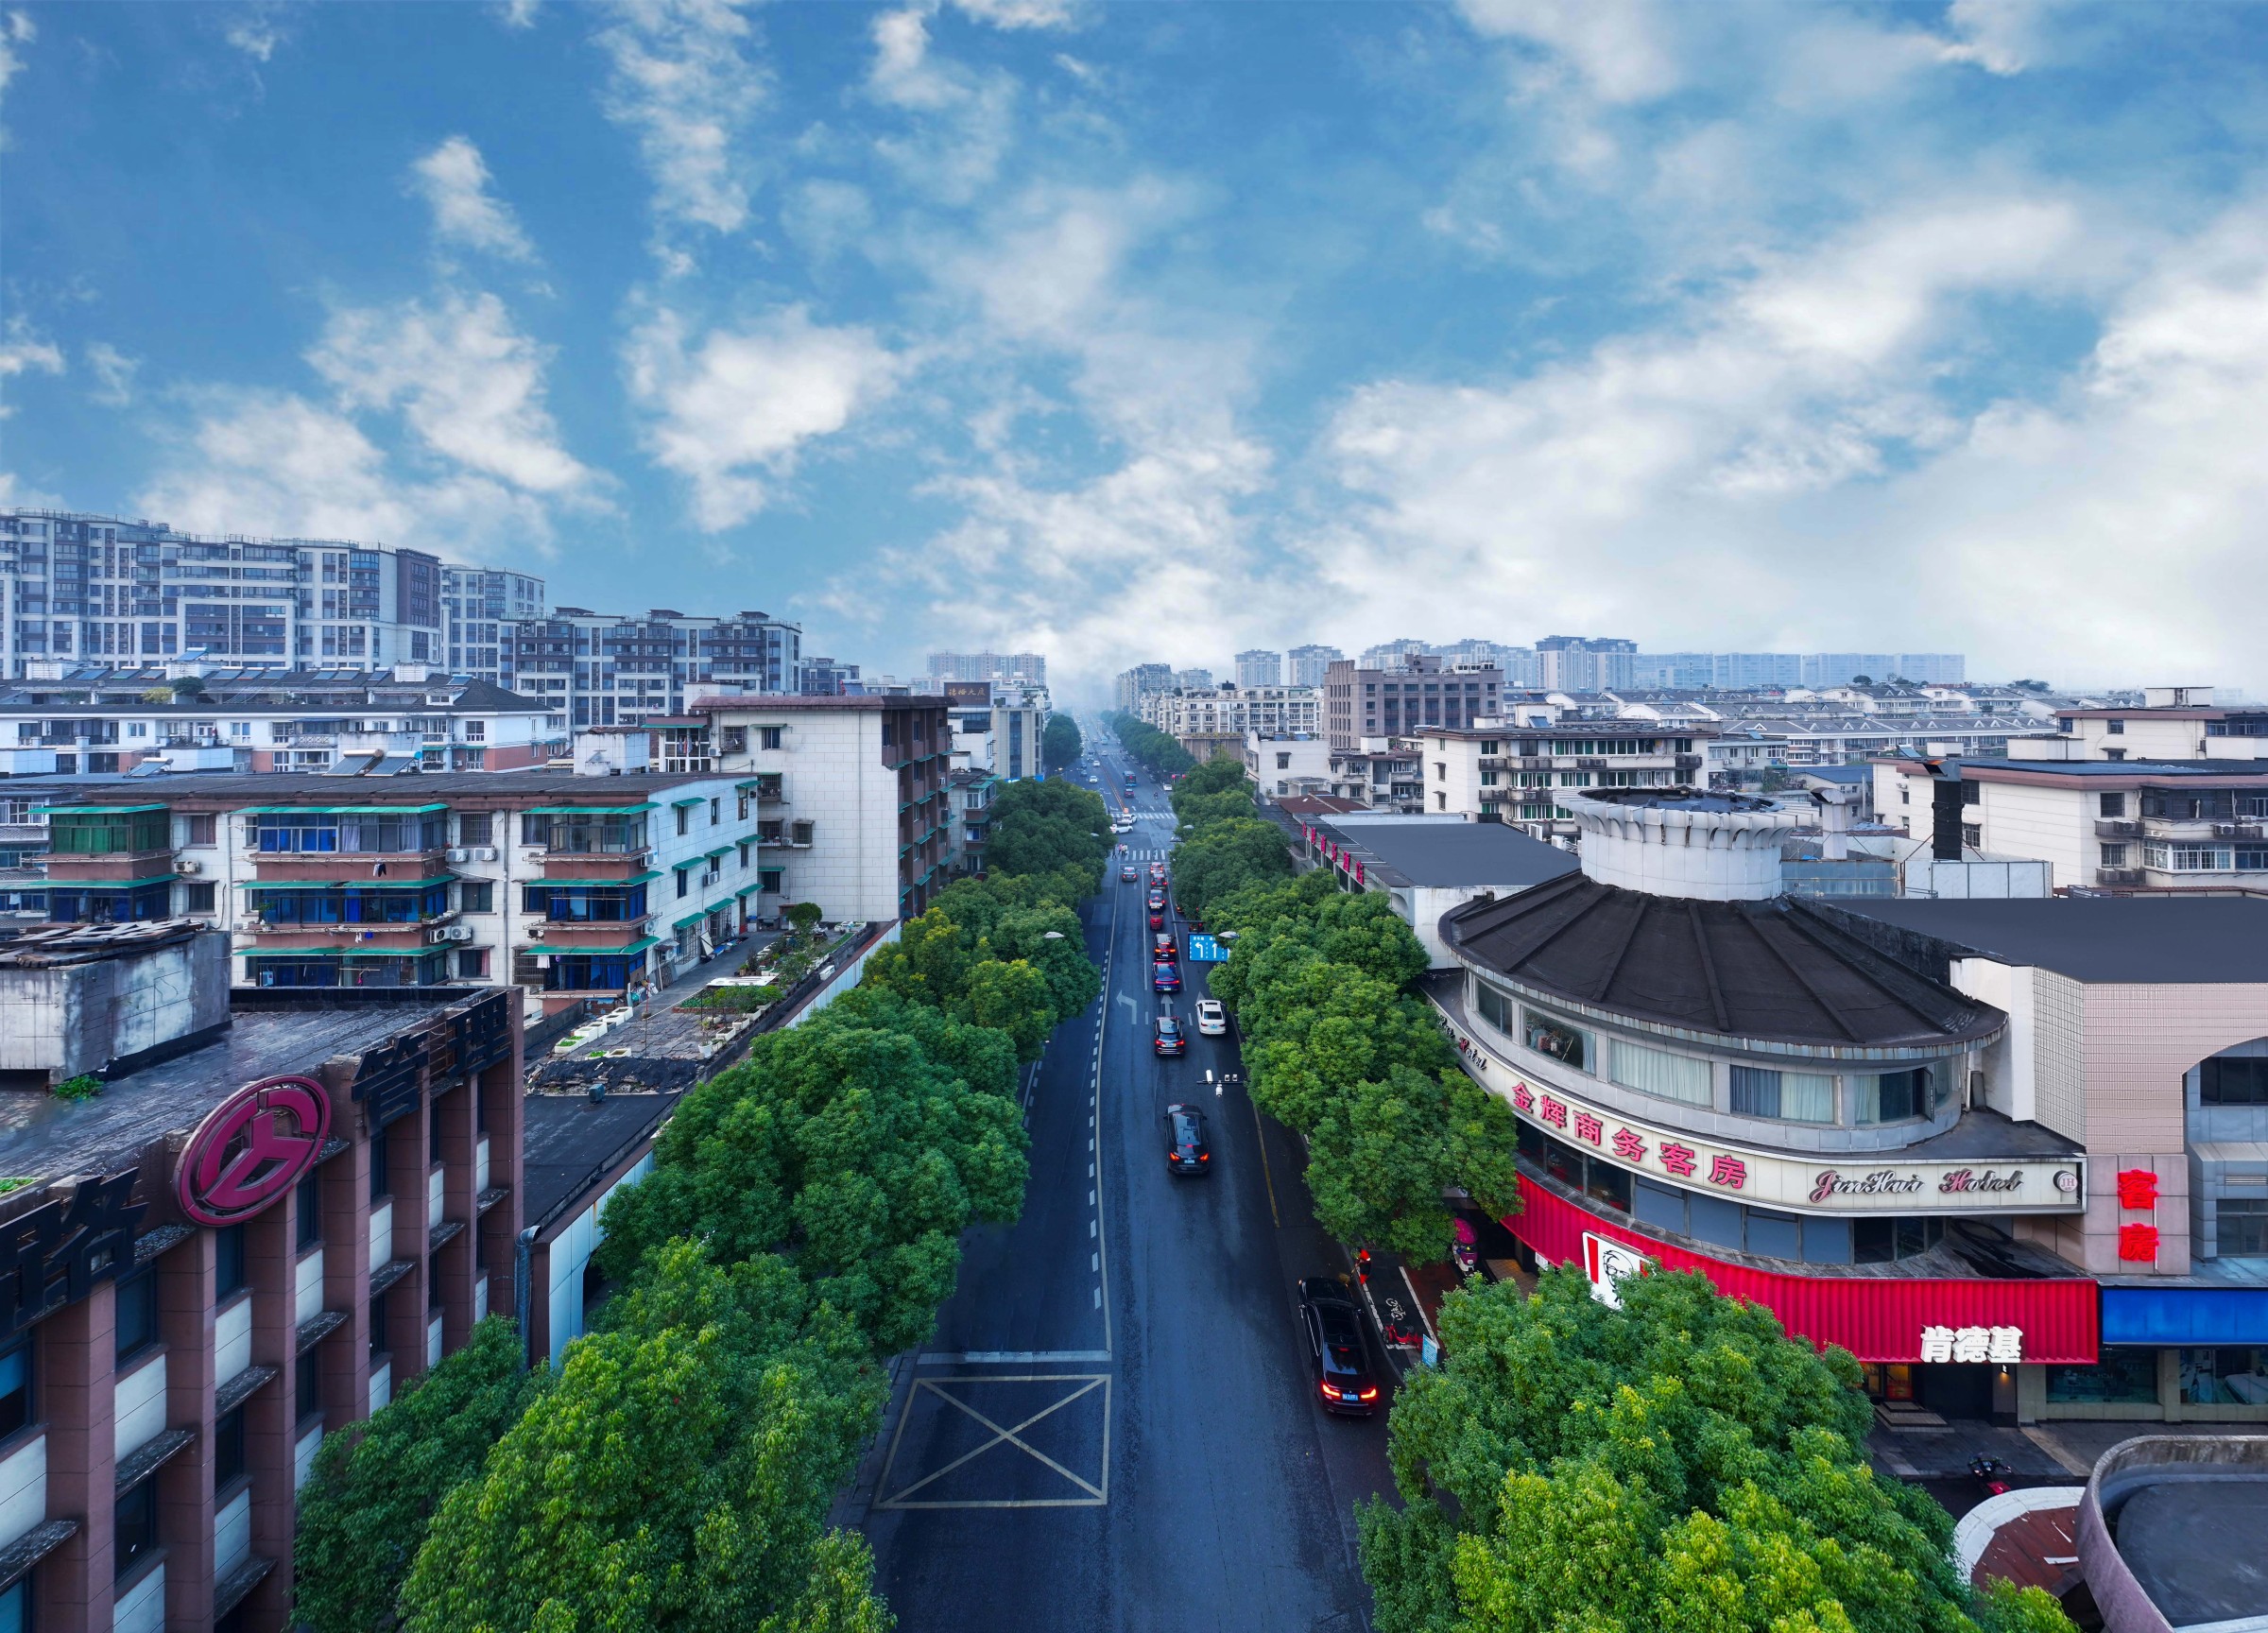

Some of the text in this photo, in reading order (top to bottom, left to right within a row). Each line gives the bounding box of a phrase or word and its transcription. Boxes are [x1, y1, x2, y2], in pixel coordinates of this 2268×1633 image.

[352, 990, 510, 1131] 管理
[1458, 1037, 1486, 1070] Hotel
[1512, 1082, 1747, 1190] 金辉商务客房
[1809, 1168, 2023, 1203] JinHui Hotel
[2061, 1177, 2075, 1187] JH
[2118, 1169, 2159, 1262] 客房
[1920, 1325, 2023, 1363] 肯德基
